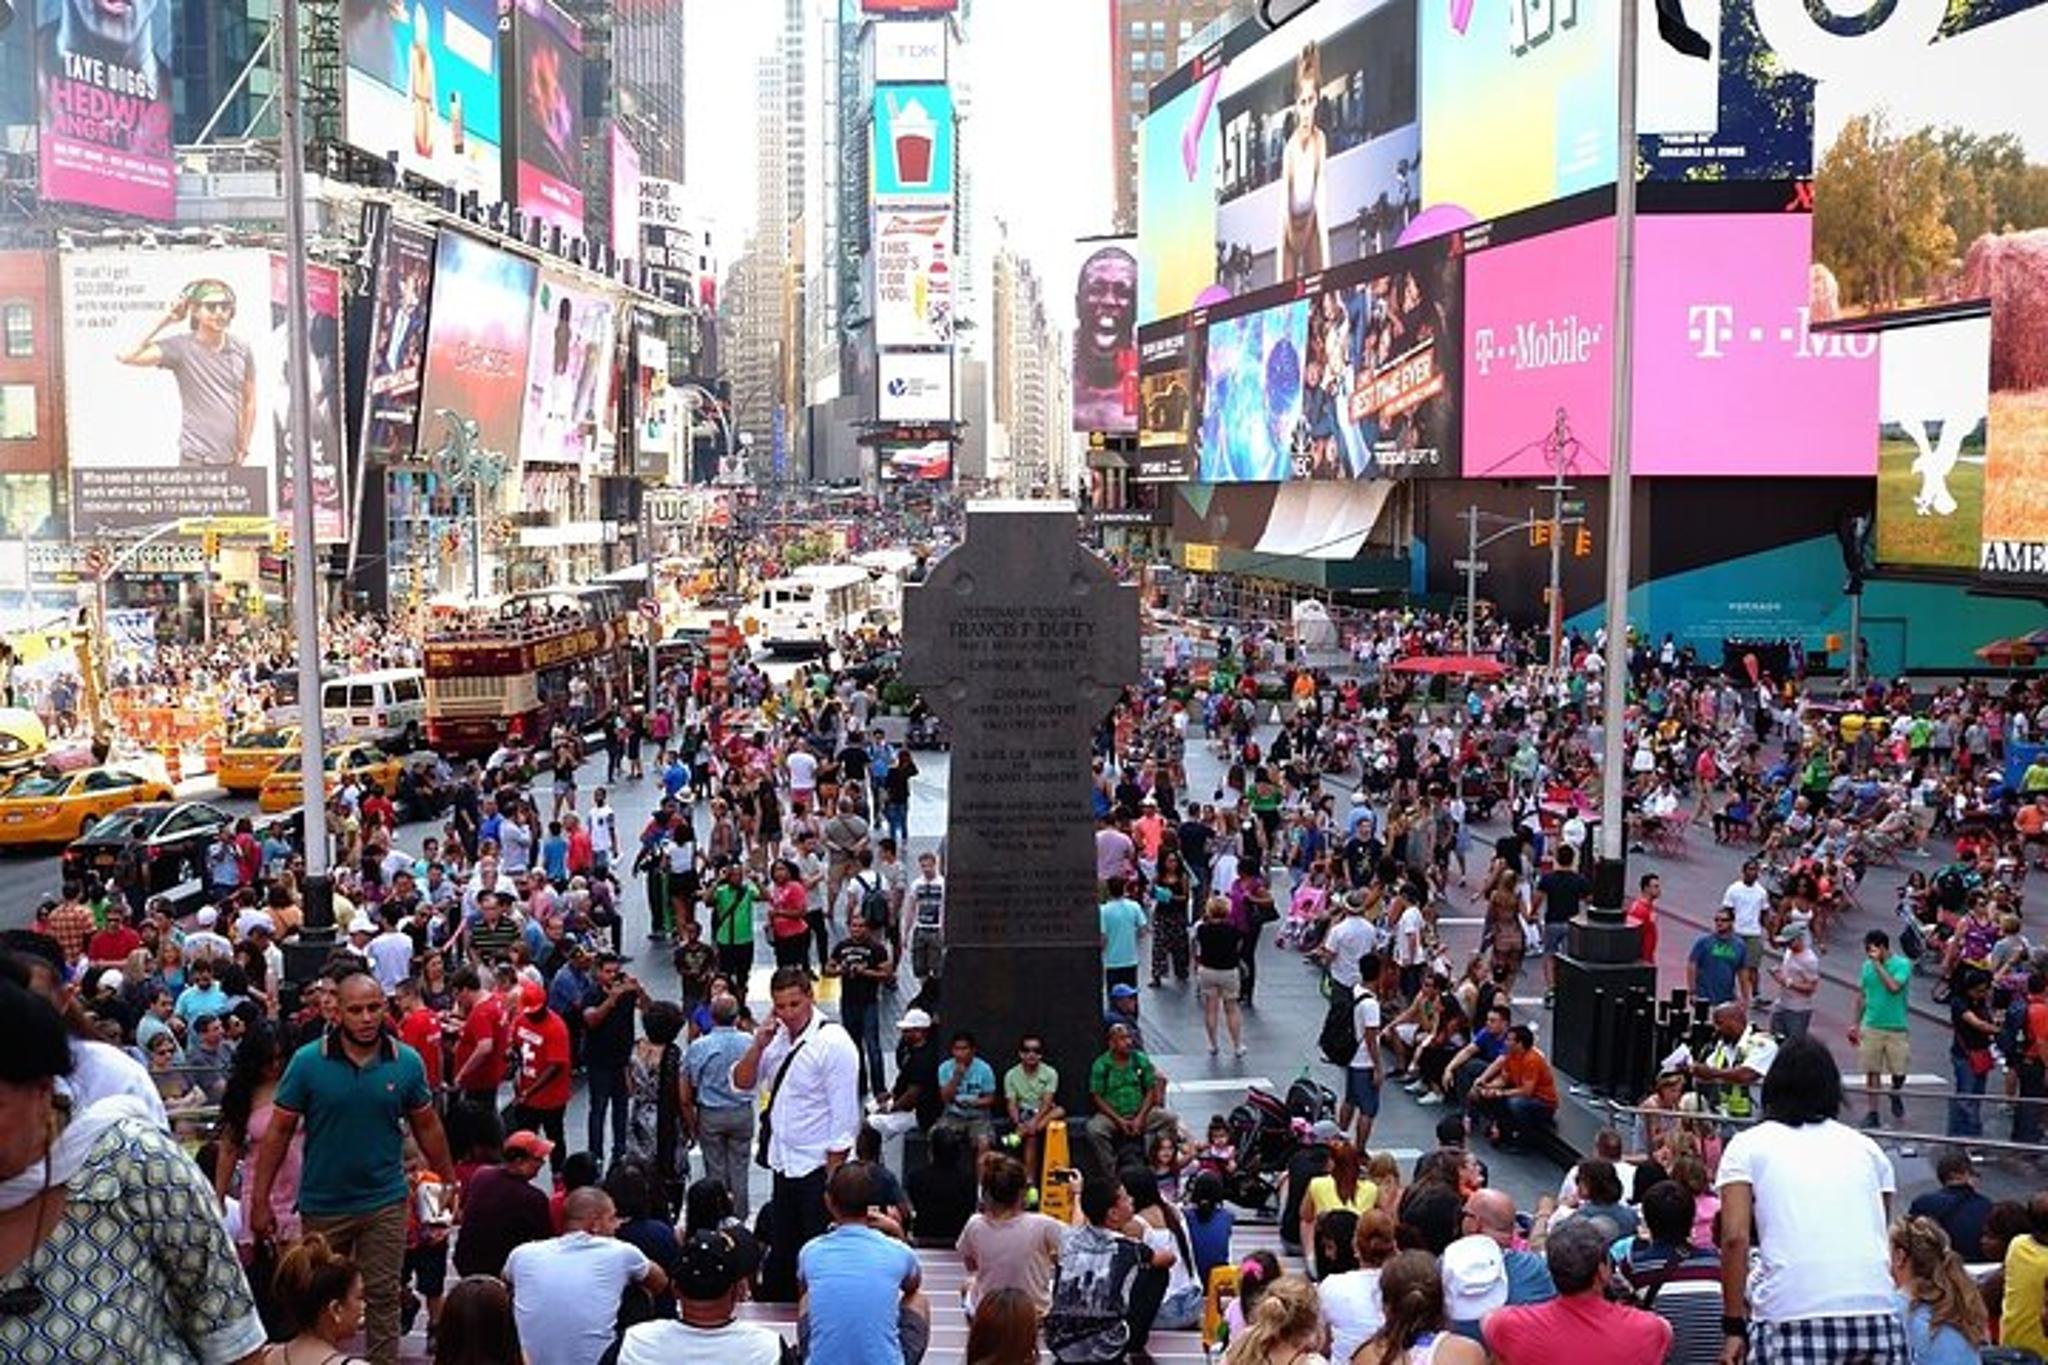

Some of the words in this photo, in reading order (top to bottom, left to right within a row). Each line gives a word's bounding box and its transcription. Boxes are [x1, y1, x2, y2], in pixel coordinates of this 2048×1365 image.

[63, 50, 104, 86] TAYE
[107, 64, 158, 100] DIGGS
[949, 621, 1018, 637] FRANCIS
[1038, 621, 1096, 637] DUFFY
